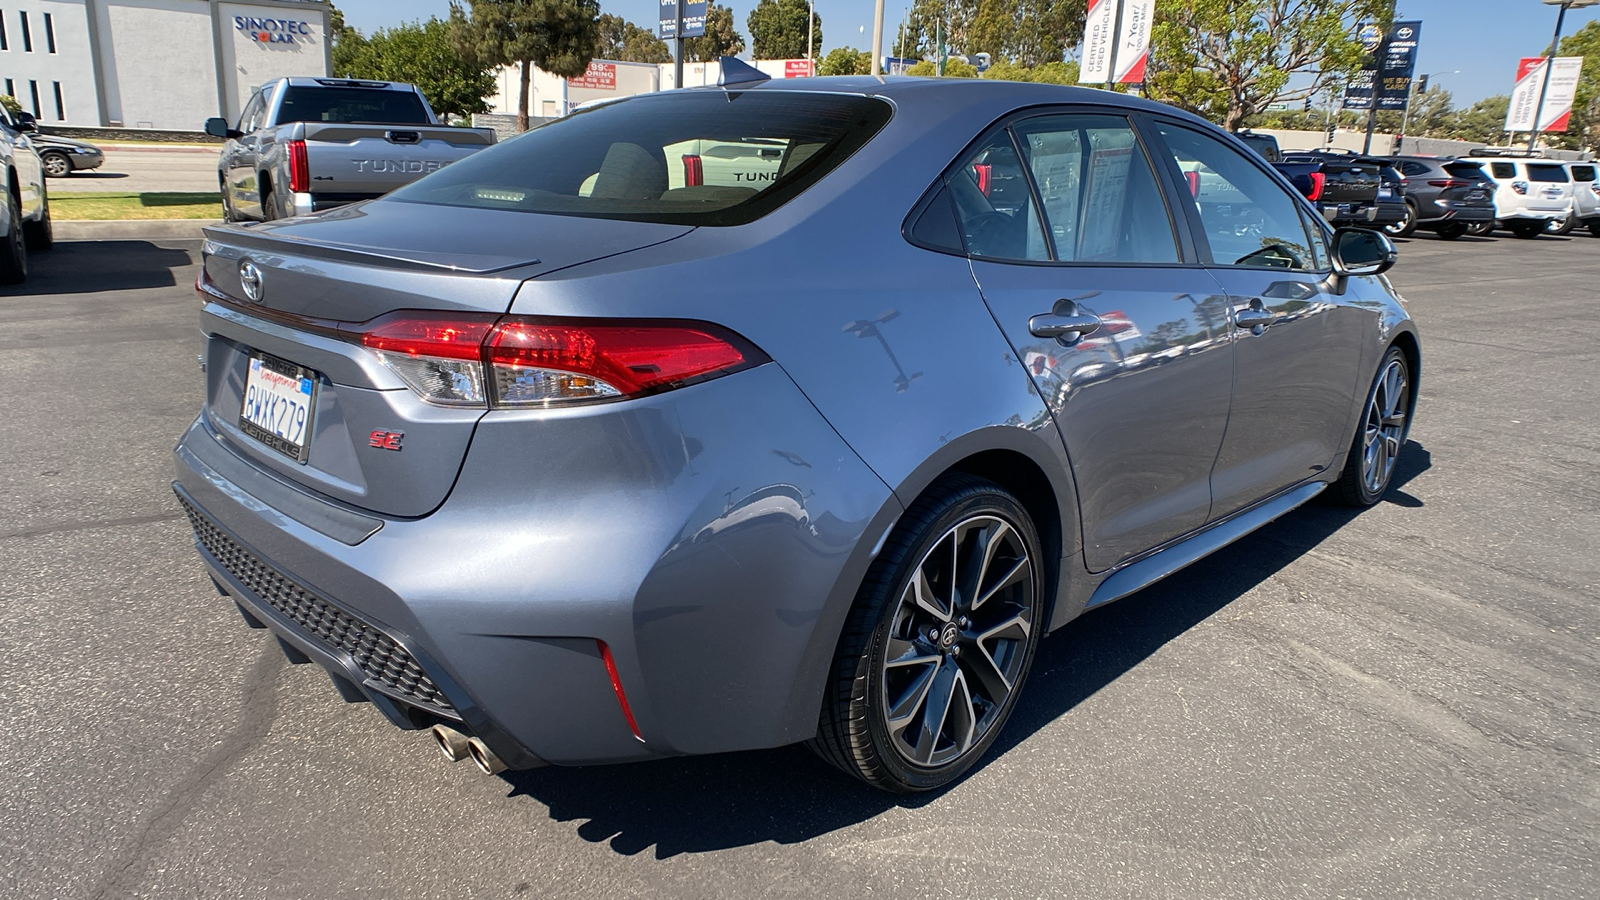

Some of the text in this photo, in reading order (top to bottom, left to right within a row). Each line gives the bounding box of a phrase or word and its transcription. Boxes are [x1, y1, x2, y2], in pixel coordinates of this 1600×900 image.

[234, 16, 308, 35] SINOTEC
[1128, 5, 1141, 38] Year/
[250, 31, 294, 44] SOLAR
[1088, 24, 1100, 72] CERTIFIED
[1096, 0, 1111, 72] USED VEHICLES
[1136, 22, 1145, 51] 100,000
[1521, 107, 1531, 123] USED
[733, 172, 777, 182] TUND
[263, 356, 297, 376] TOYOTA
[260, 368, 301, 393] California
[245, 384, 306, 443] 8WXK279
[368, 427, 405, 451] SE
